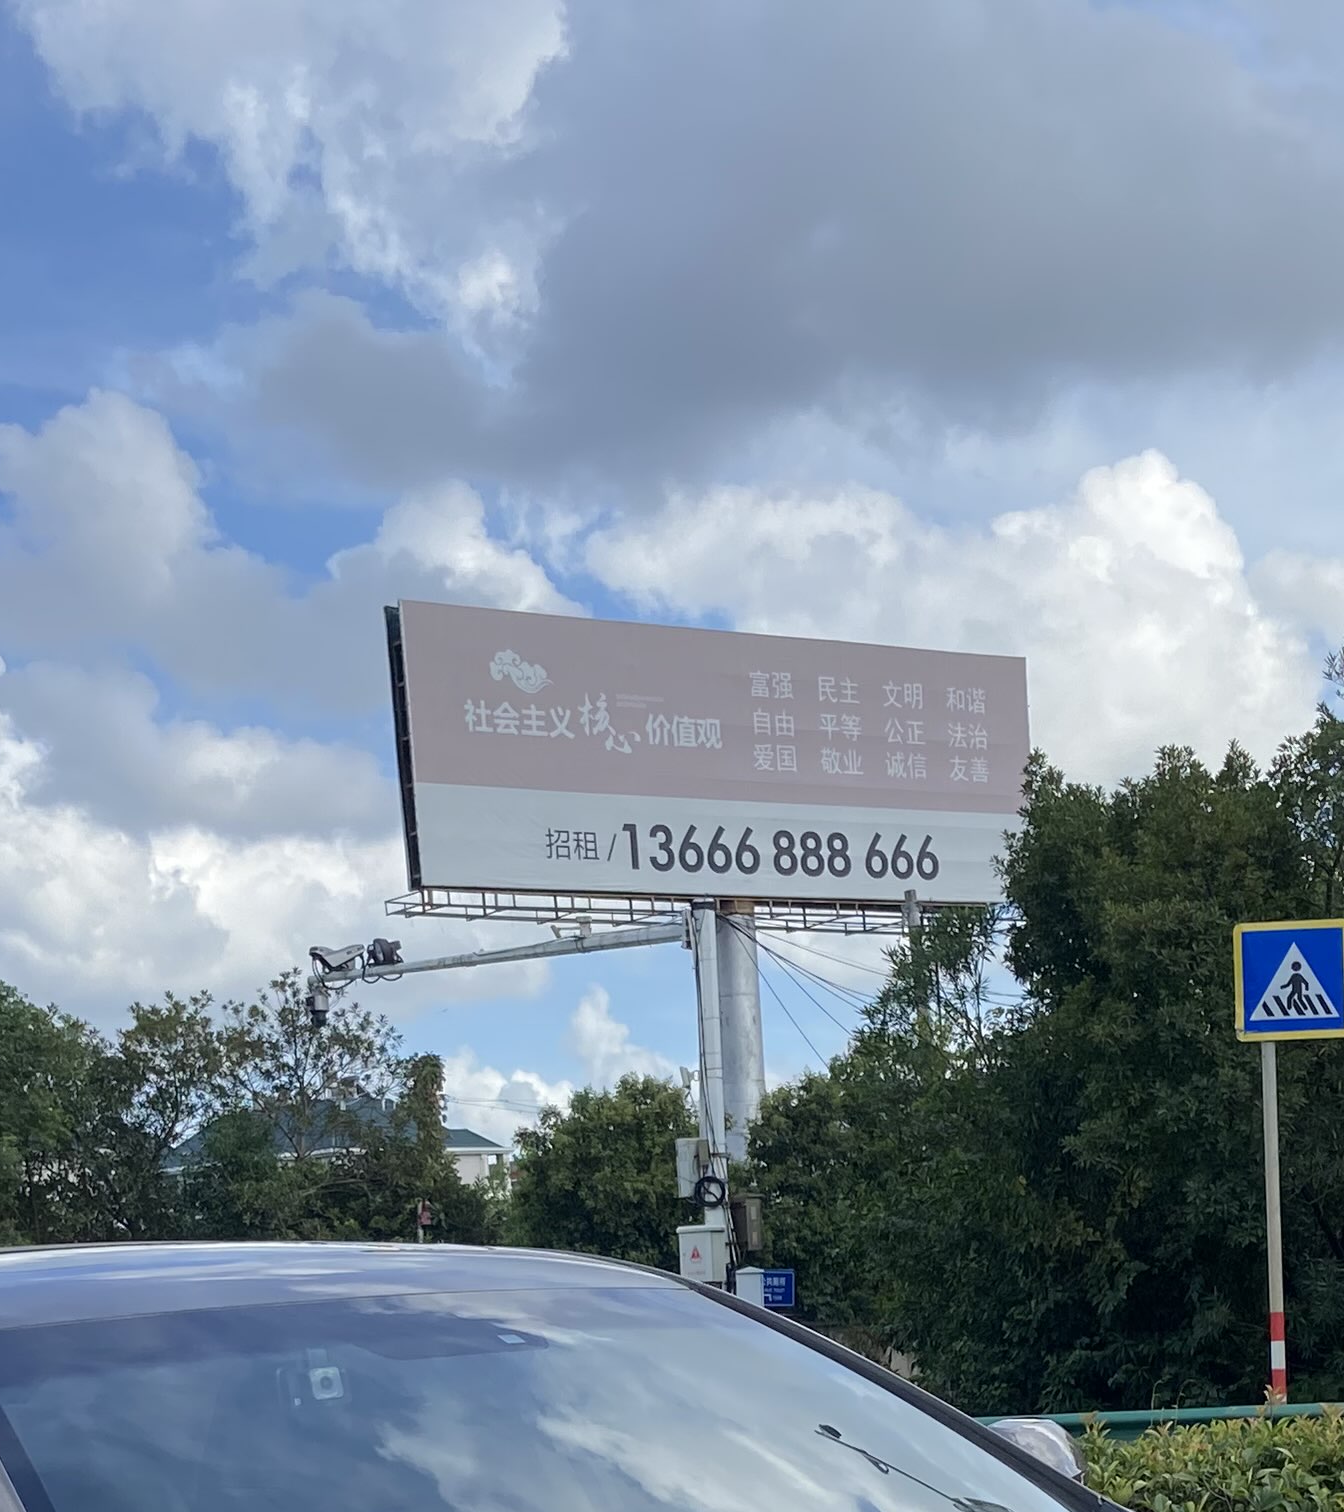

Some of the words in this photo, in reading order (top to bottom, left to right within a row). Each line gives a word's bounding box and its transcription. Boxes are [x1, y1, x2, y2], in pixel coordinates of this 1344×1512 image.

[749, 670, 794, 699] 富强
[818, 676, 860, 704] 民主
[882, 680, 923, 709] 文明
[947, 687, 986, 714] 和谐
[464, 693, 723, 754] 社会主义核心价值观
[753, 708, 795, 737] 自由
[819, 713, 862, 741] 平等
[884, 717, 926, 745] 公正
[948, 722, 988, 750] 法治
[754, 744, 797, 772] 爱国
[821, 750, 864, 776] 敬业
[885, 752, 927, 779] 诚信
[950, 755, 989, 783] 友善
[545, 827, 600, 861] 招租
[622, 823, 761, 874] 13666
[773, 830, 851, 877] 888
[865, 832, 940, 881] 666
